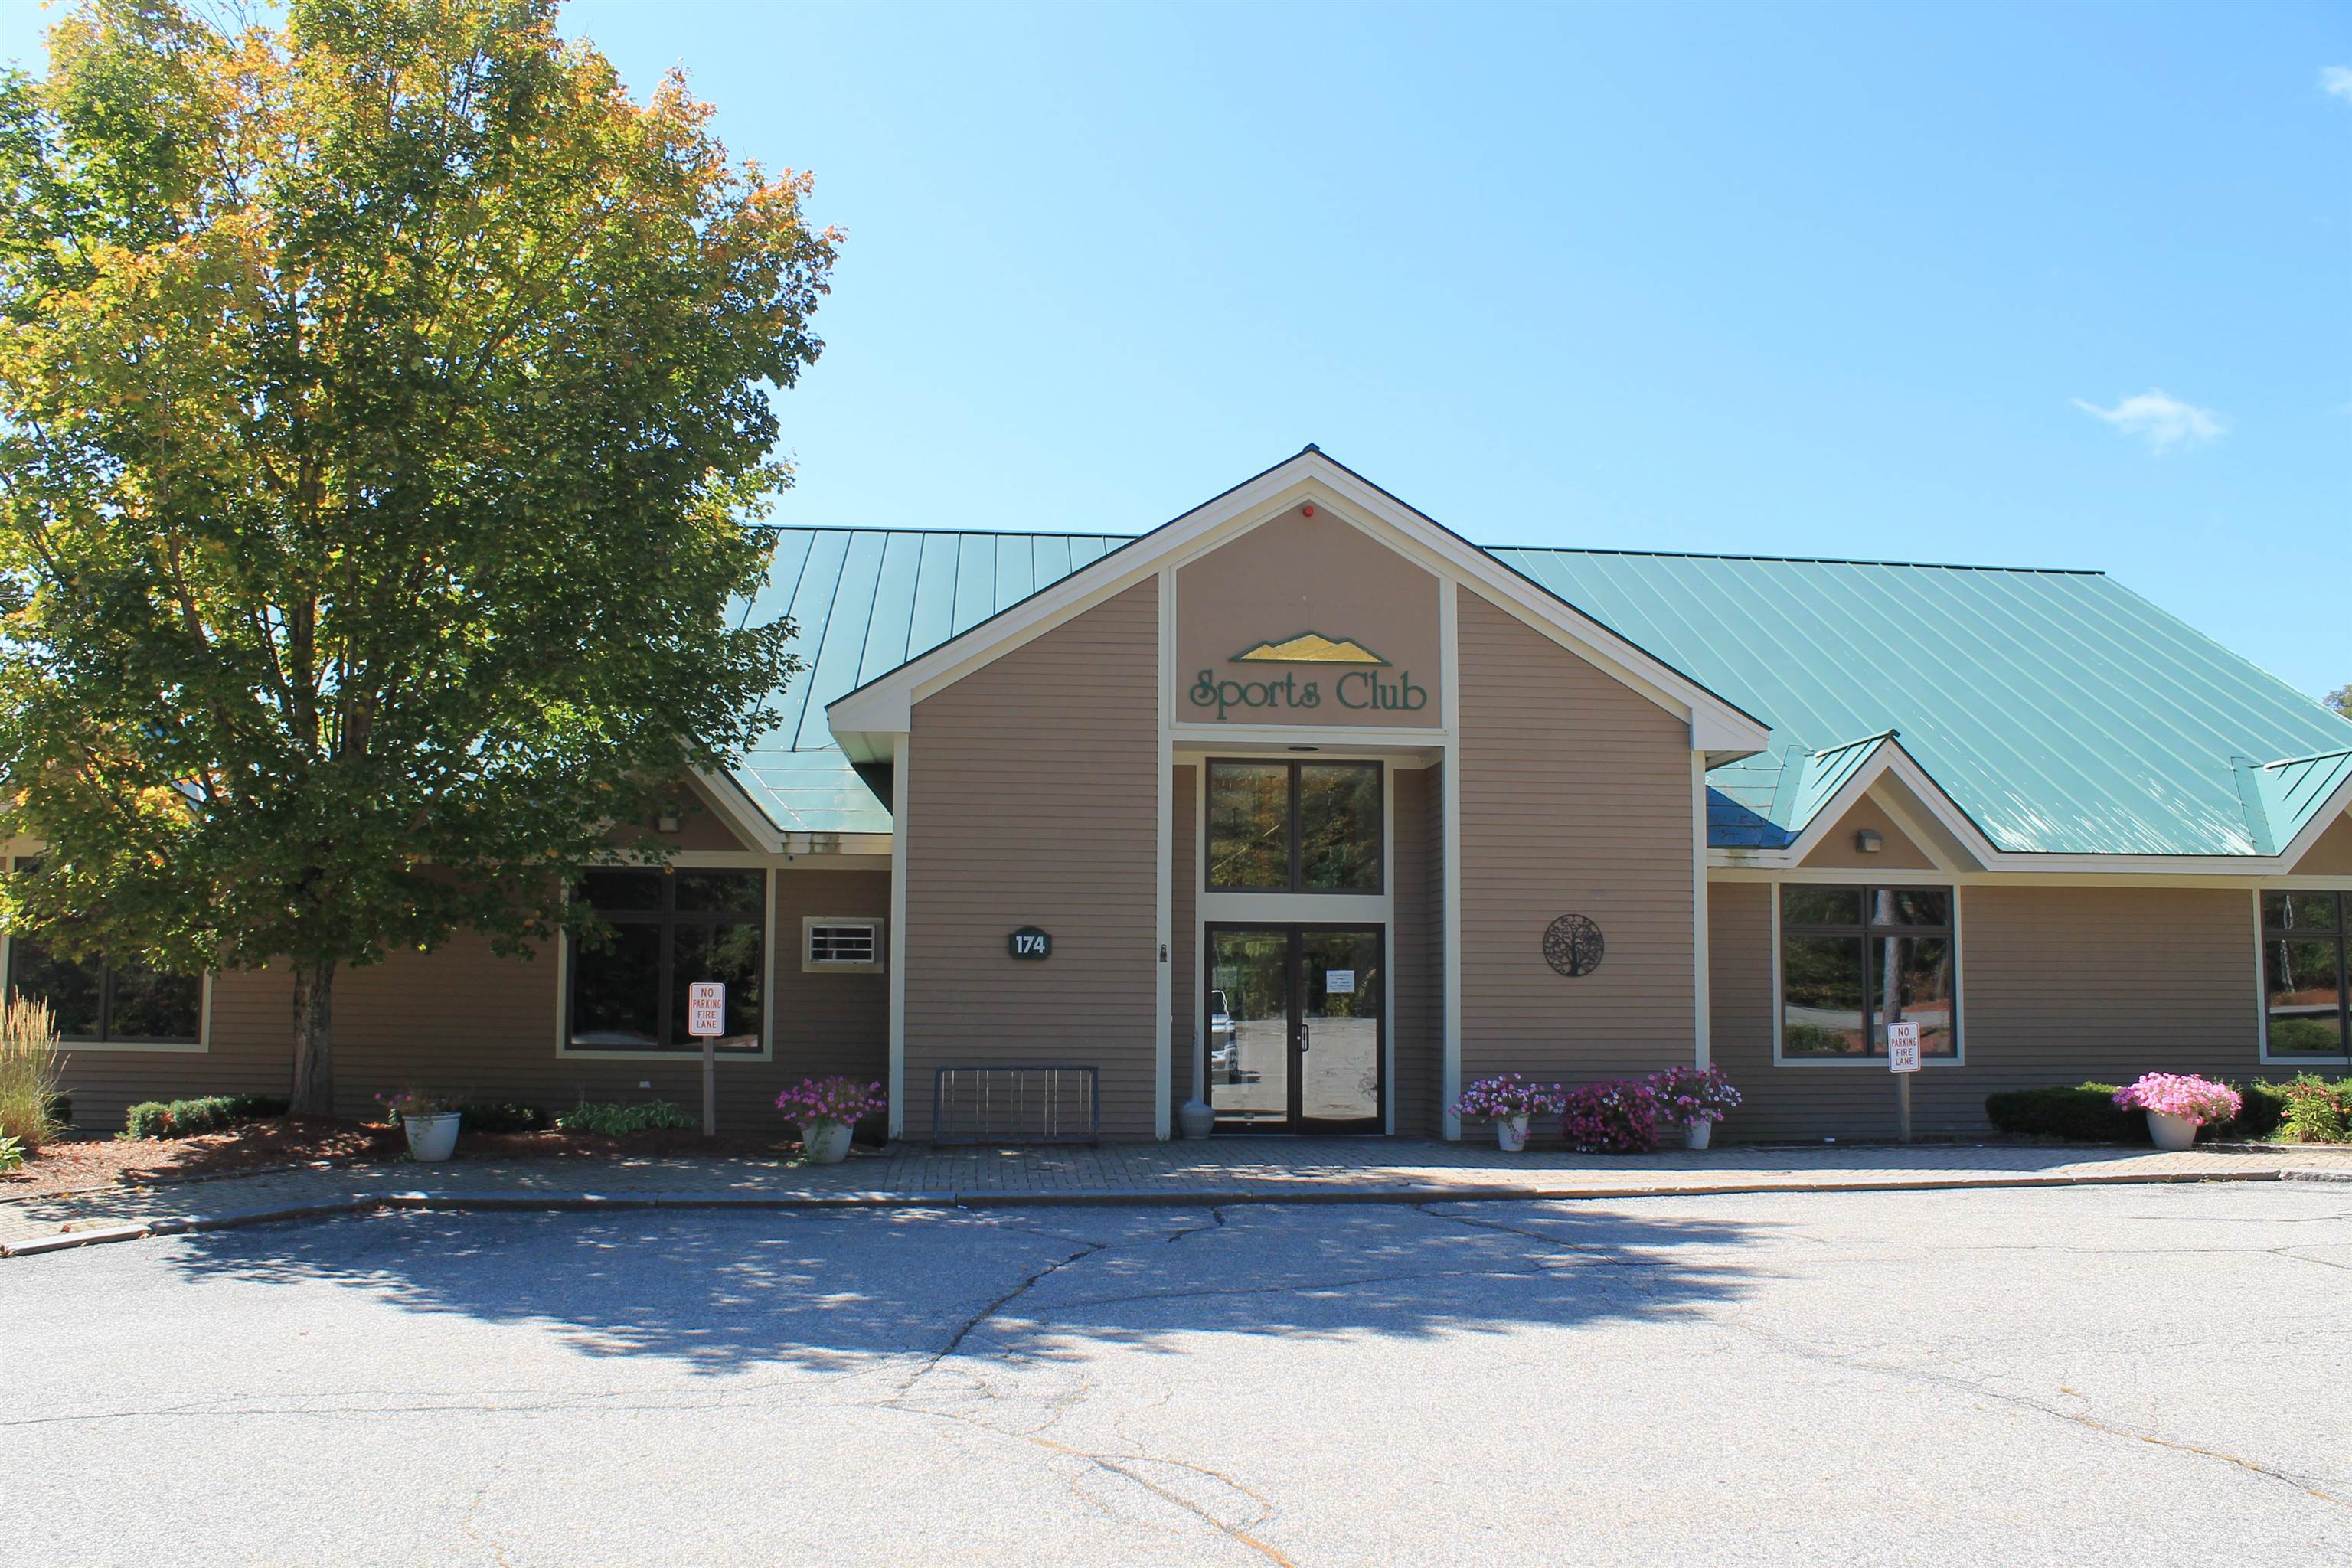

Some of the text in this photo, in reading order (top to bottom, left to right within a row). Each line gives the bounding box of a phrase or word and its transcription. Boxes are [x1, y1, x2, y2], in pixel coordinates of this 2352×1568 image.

[1190, 668, 1427, 720] Sports Club
[1016, 936, 1045, 954] 174
[701, 988, 714, 997] NO
[693, 999, 722, 1008] PARKING
[1898, 1027, 1909, 1036] NO
[1891, 1037, 1917, 1047] PARKING
